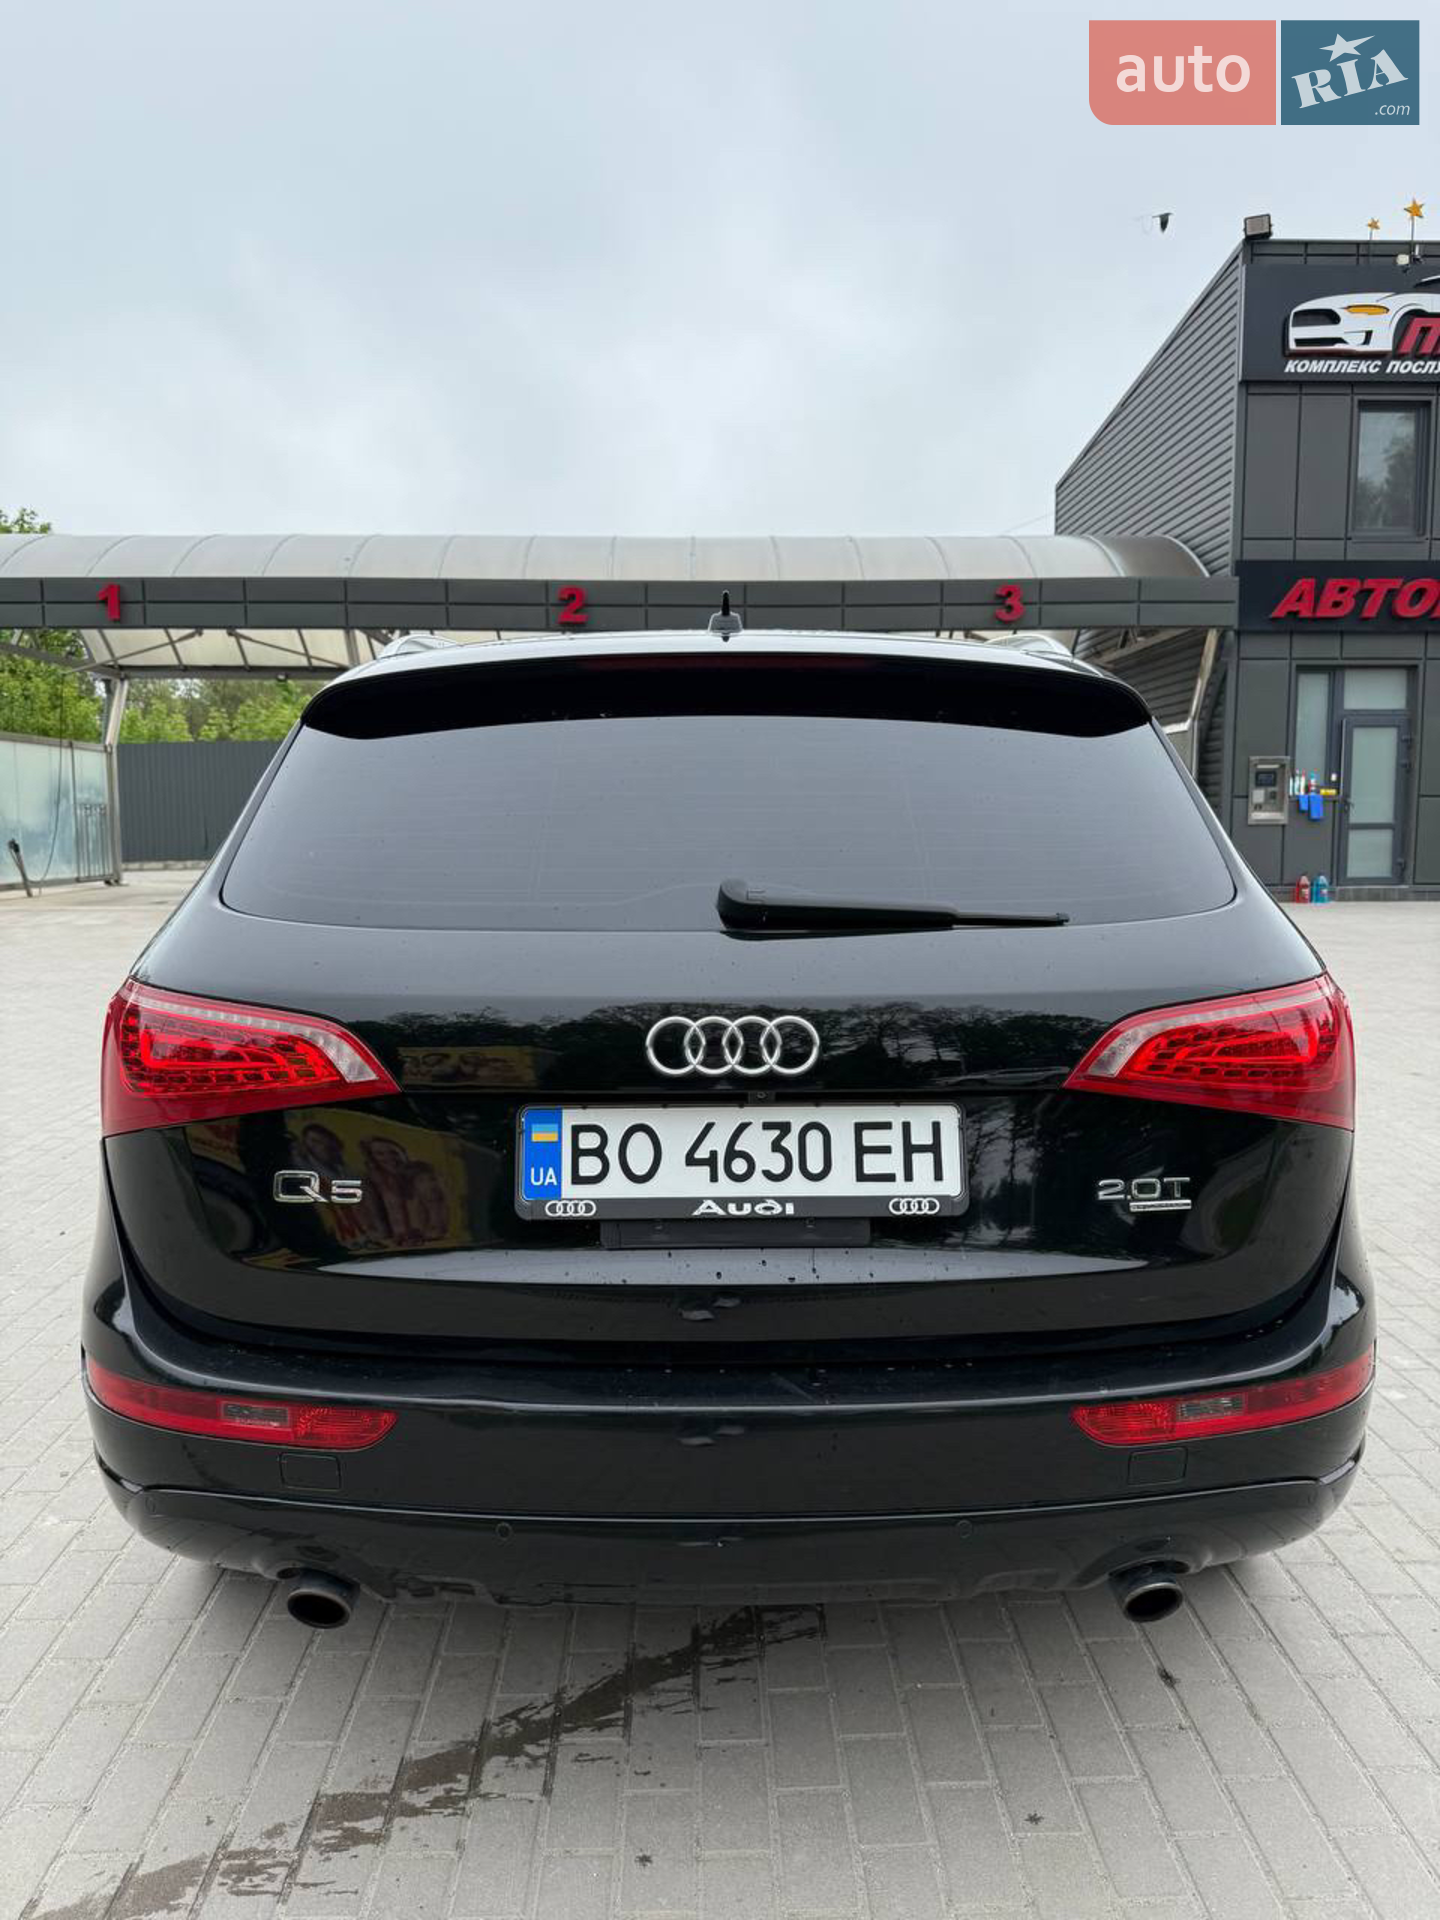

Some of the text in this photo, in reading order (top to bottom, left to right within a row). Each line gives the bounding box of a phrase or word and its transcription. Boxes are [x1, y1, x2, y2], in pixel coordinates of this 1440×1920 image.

[1398, 317, 1440, 355] П
[1284, 360, 1381, 374] КОМПЛЕКС
[97, 583, 121, 621] 1
[558, 587, 588, 624] 2
[995, 584, 1025, 622] 3
[1271, 578, 1440, 619] АВТО
[570, 1121, 944, 1185] BO 4630 EH
[273, 1171, 363, 1204] Q5
[530, 1169, 557, 1186] UA
[1098, 1177, 1190, 1200] 2.0T
[692, 1199, 795, 1216] Audi
